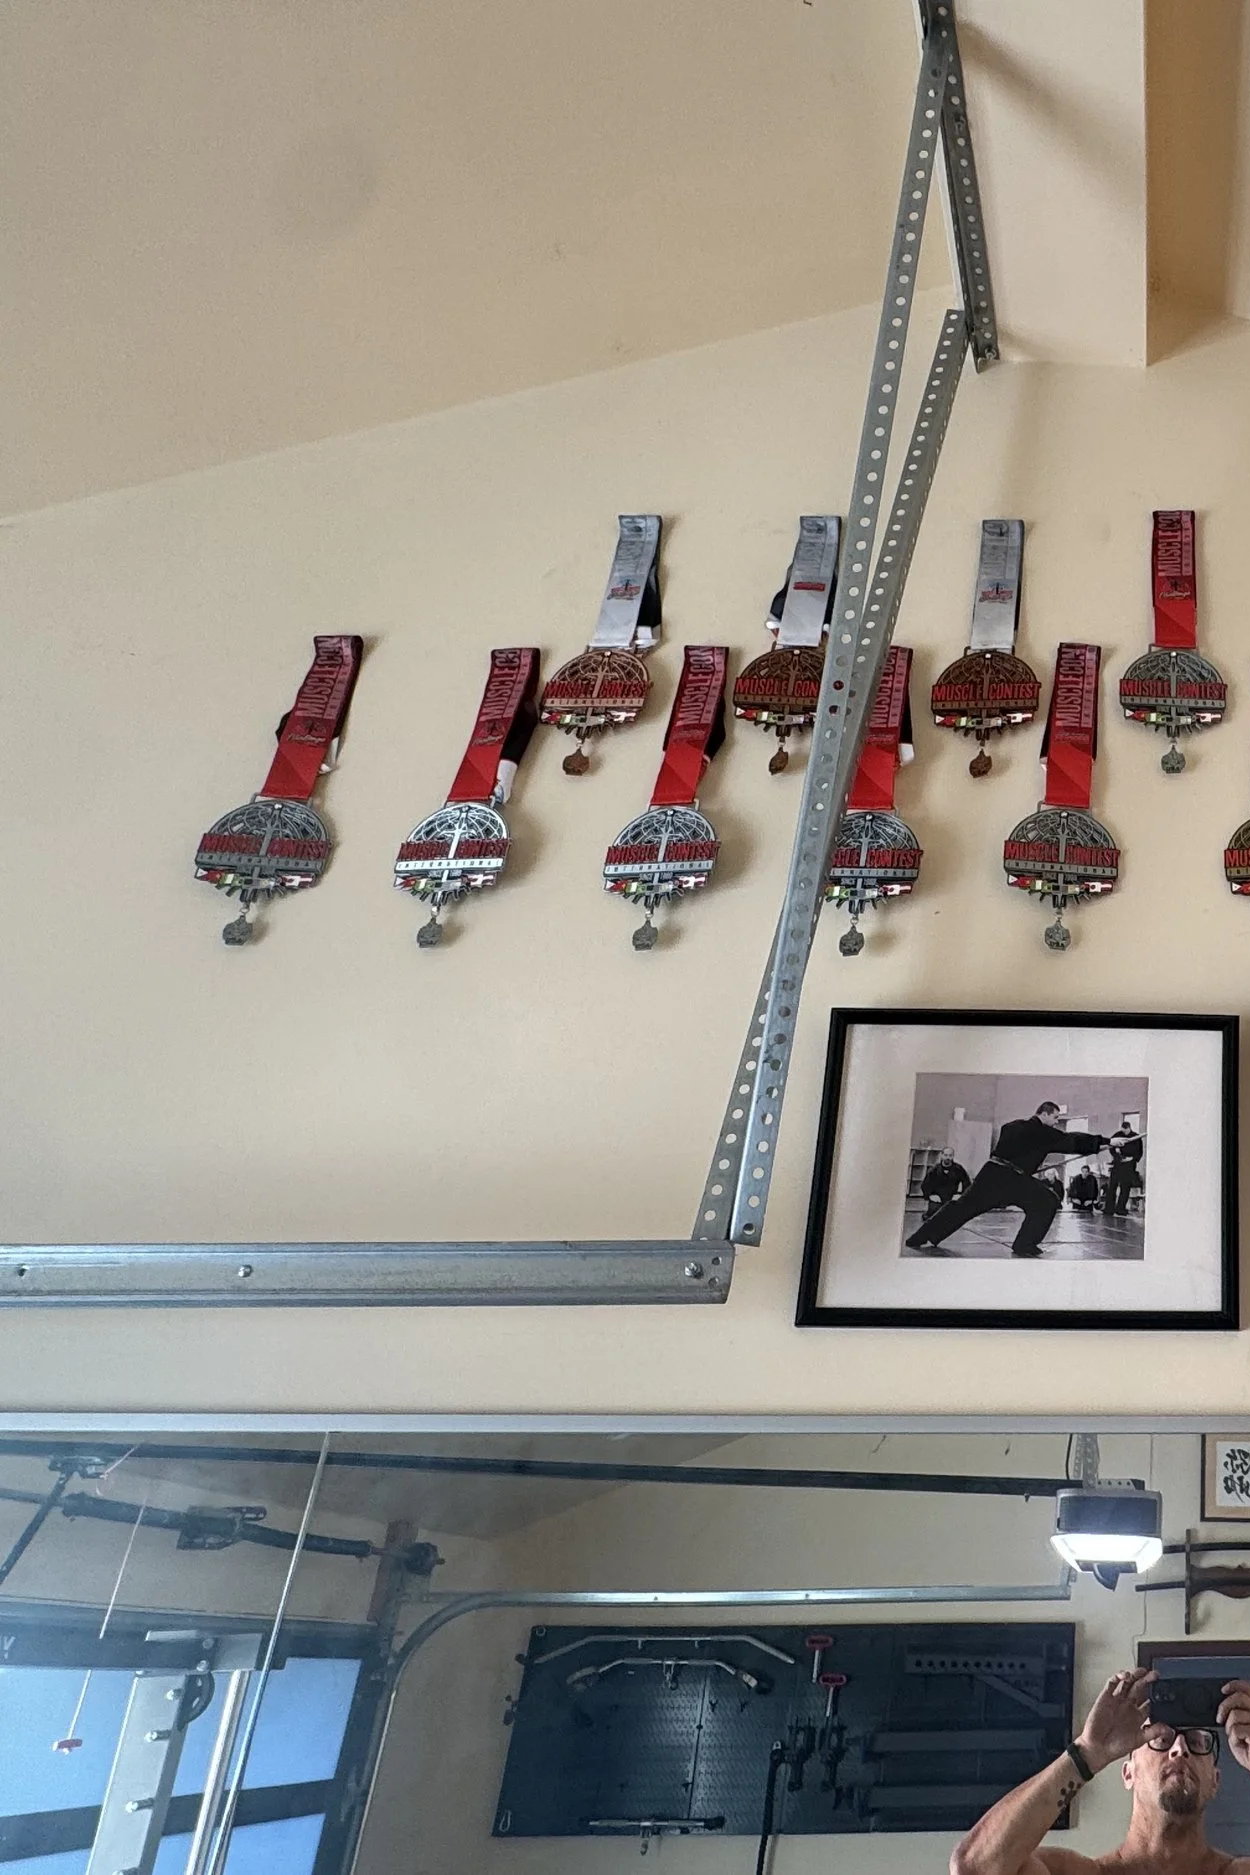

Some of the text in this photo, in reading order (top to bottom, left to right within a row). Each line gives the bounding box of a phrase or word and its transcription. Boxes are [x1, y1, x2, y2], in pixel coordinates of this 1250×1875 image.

[735, 678, 789, 696] MUSCLE
[933, 682, 1041, 701] MUSCLE CONTEST
[1004, 840, 1059, 862] MUSCLE
